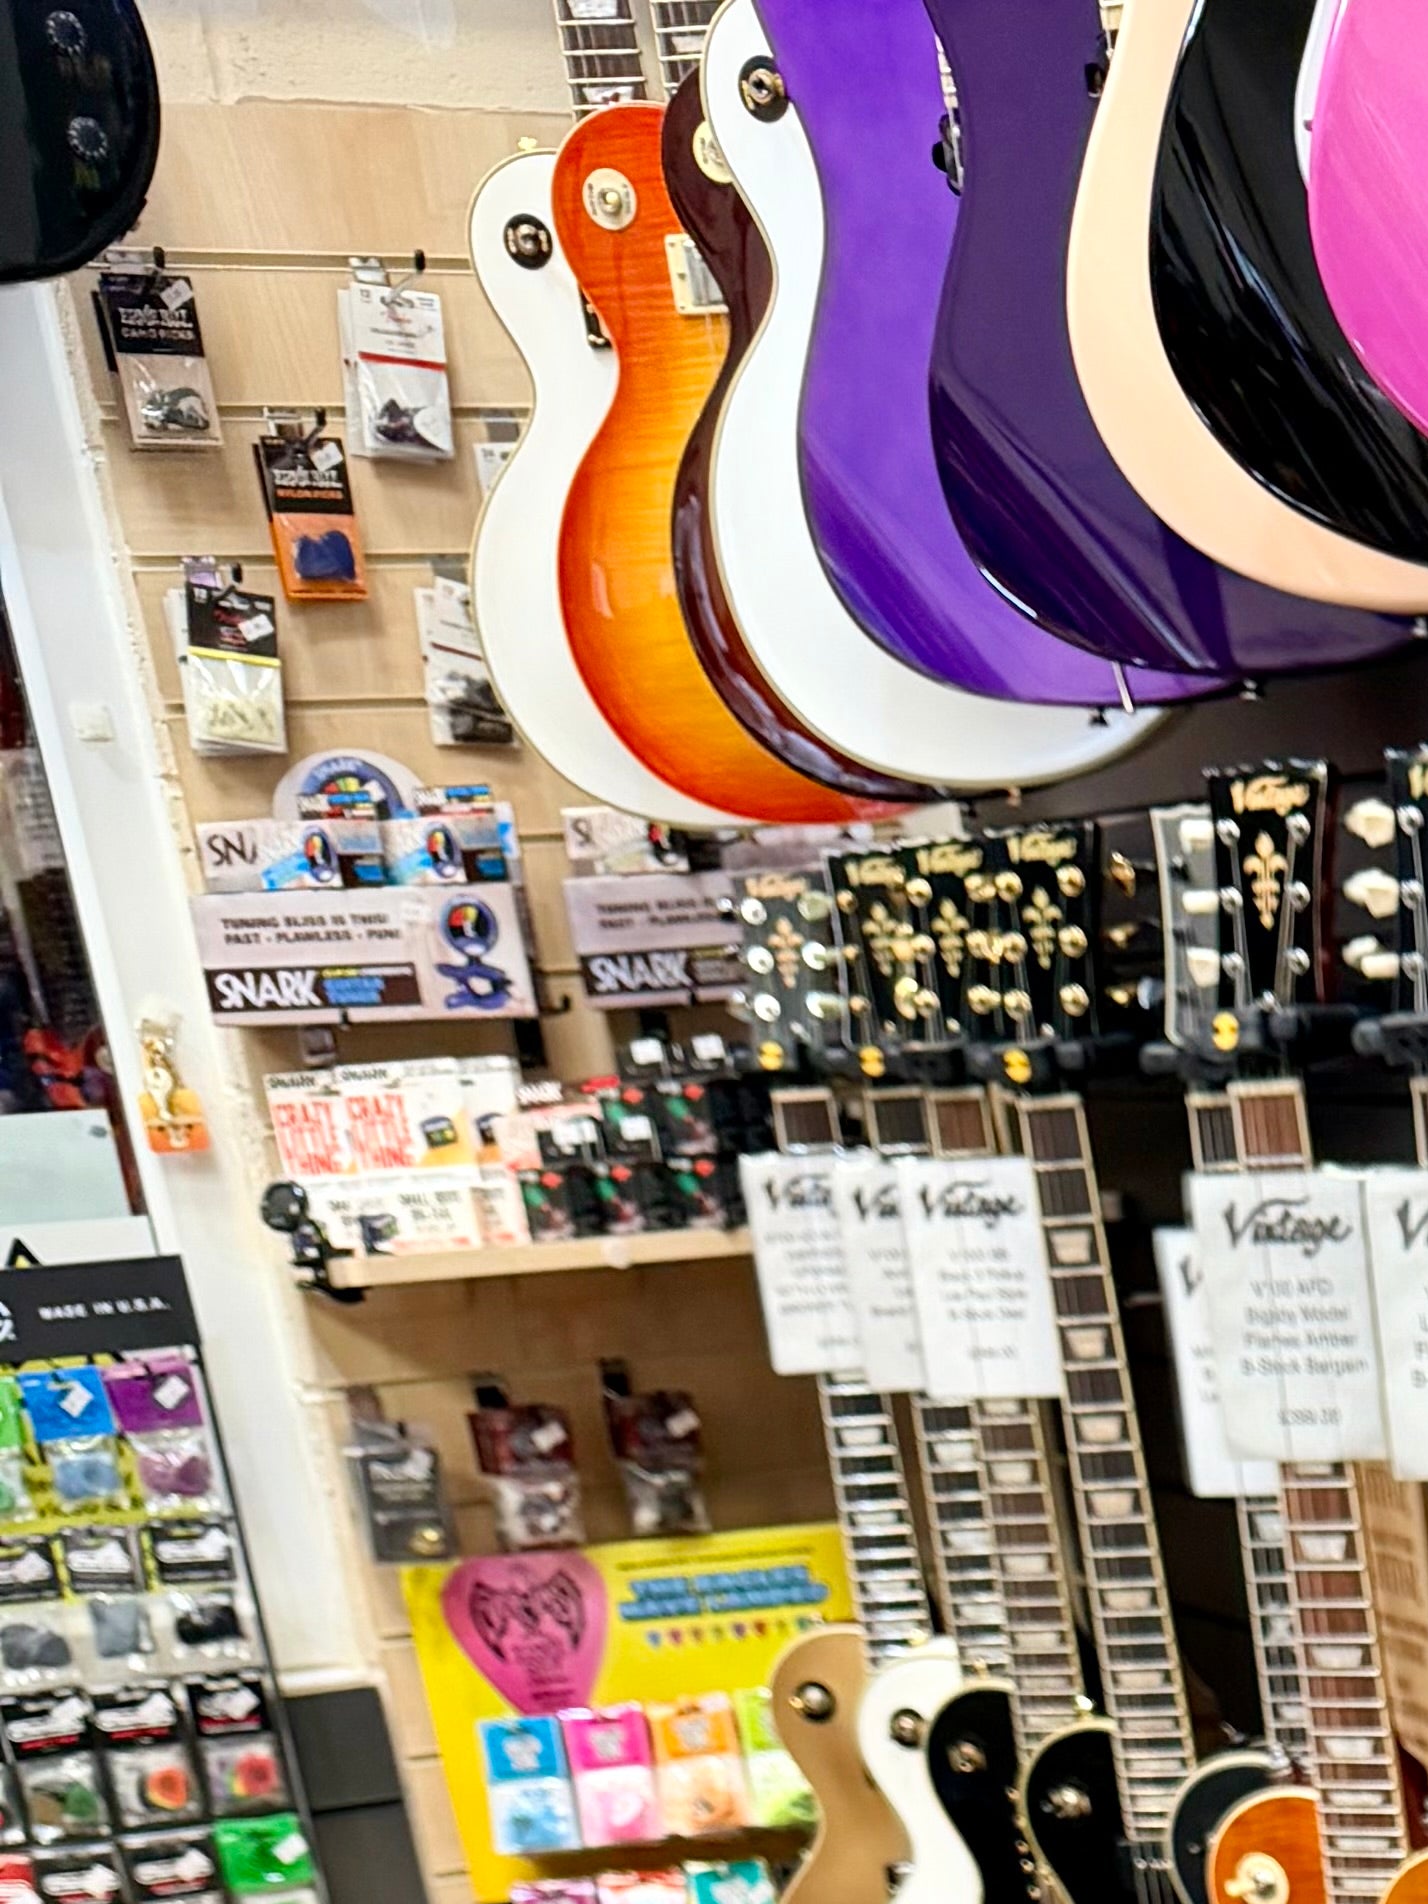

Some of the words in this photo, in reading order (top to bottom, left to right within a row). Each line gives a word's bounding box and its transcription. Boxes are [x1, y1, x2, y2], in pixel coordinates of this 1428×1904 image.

[214, 969, 323, 1011] SNARK
[586, 950, 695, 993] SNARK
[1223, 1197, 1352, 1258] Vintage
